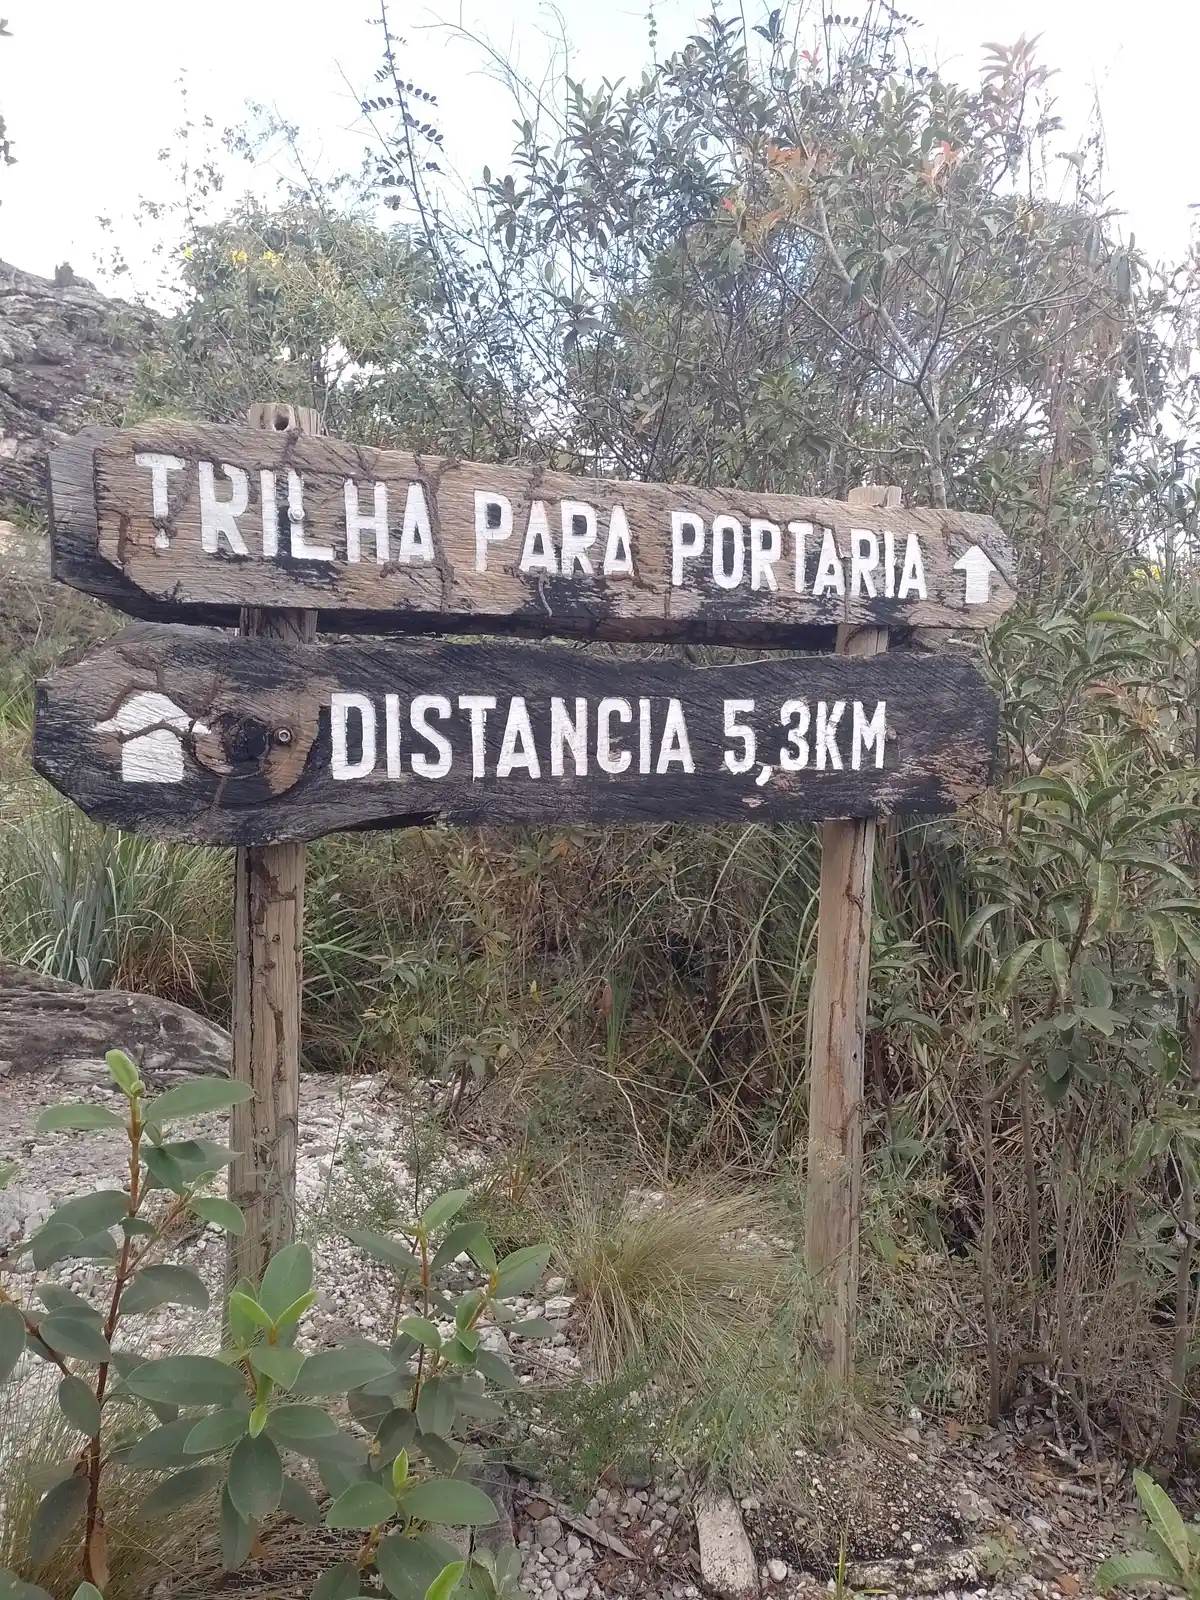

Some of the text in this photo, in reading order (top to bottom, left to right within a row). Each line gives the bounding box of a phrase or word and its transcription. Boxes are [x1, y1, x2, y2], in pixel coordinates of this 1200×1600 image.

[135, 452, 928, 600] TRILHA PARA PORTARIA
[330, 692, 887, 787] DISTANCIA 5,3KM
